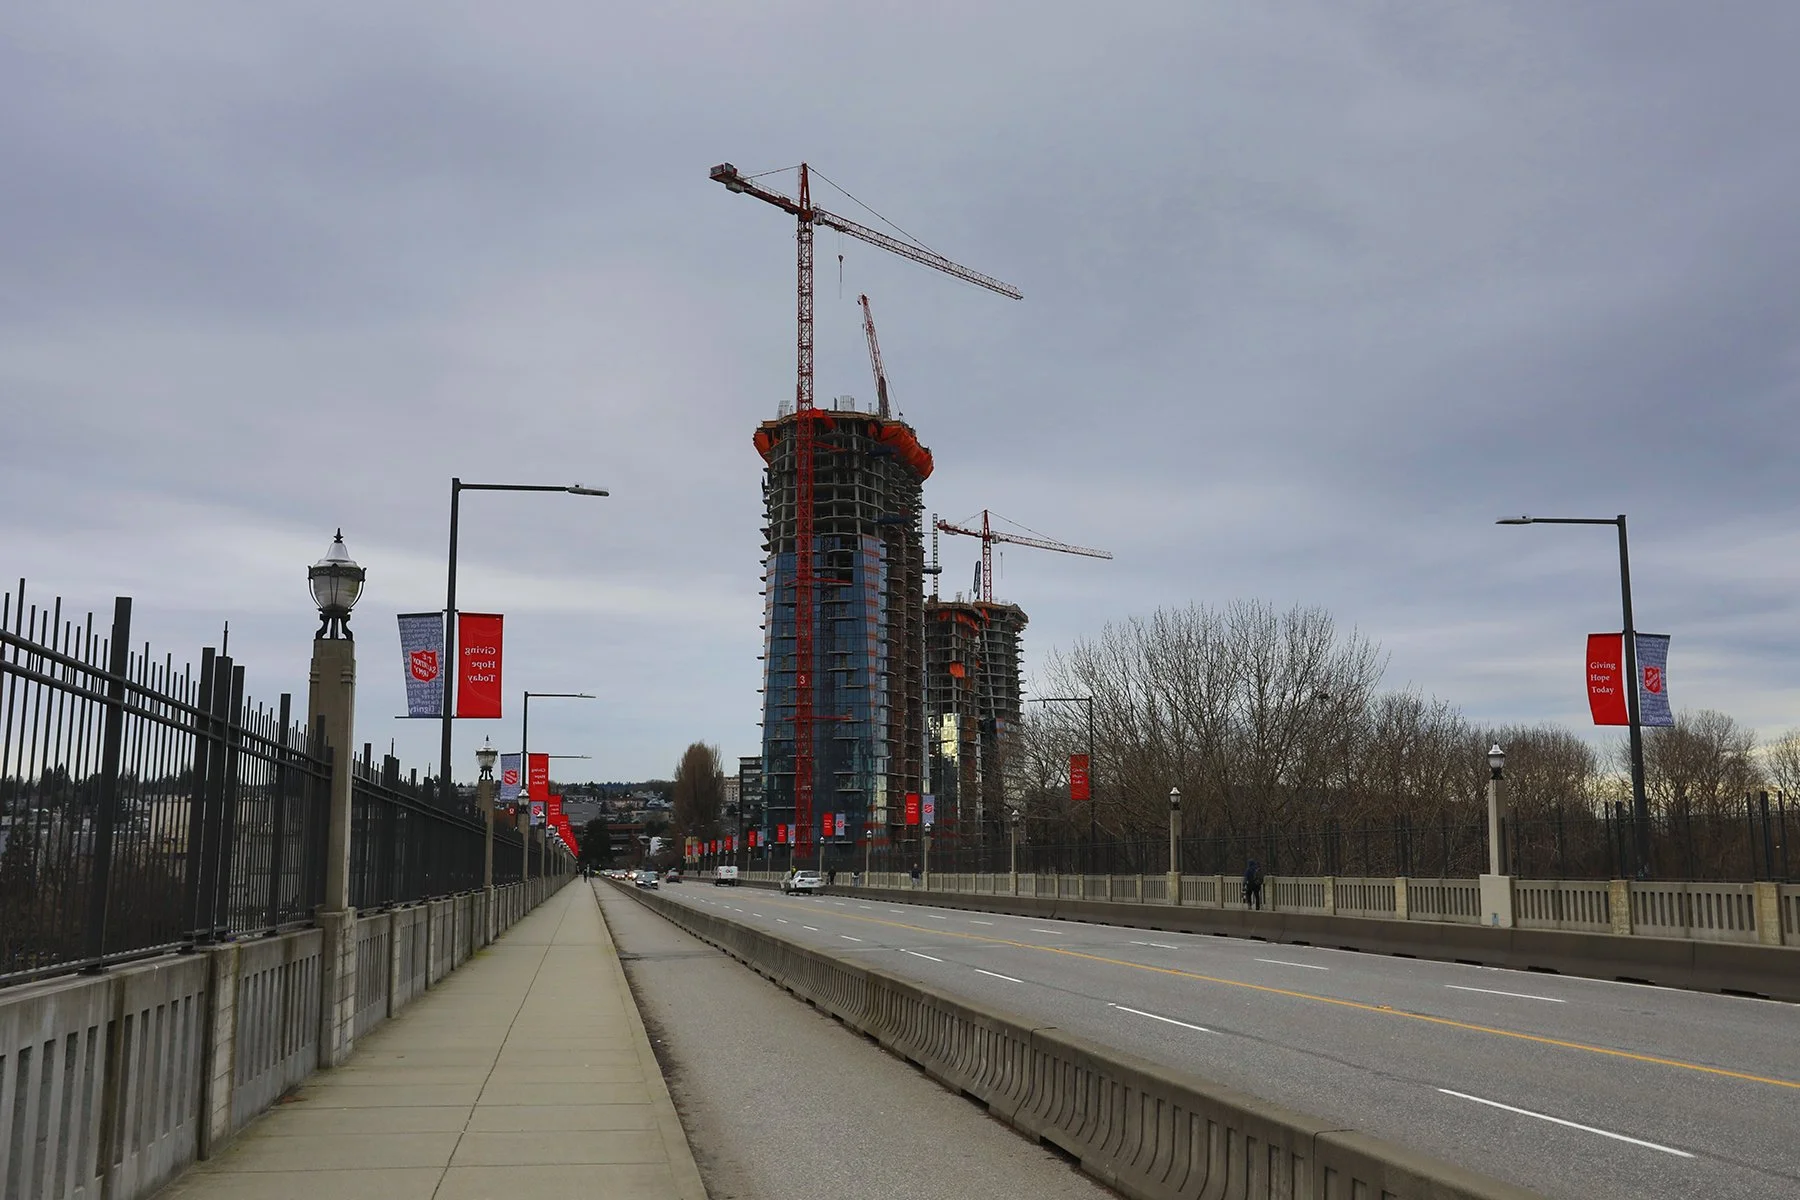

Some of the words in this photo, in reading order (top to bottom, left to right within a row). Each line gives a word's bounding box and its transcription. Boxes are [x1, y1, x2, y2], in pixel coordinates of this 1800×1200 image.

[1590, 662, 1616, 670] Giving
[800, 675, 805, 684] 3
[1590, 674, 1610, 683] Hope
[1592, 686, 1614, 695] Today
